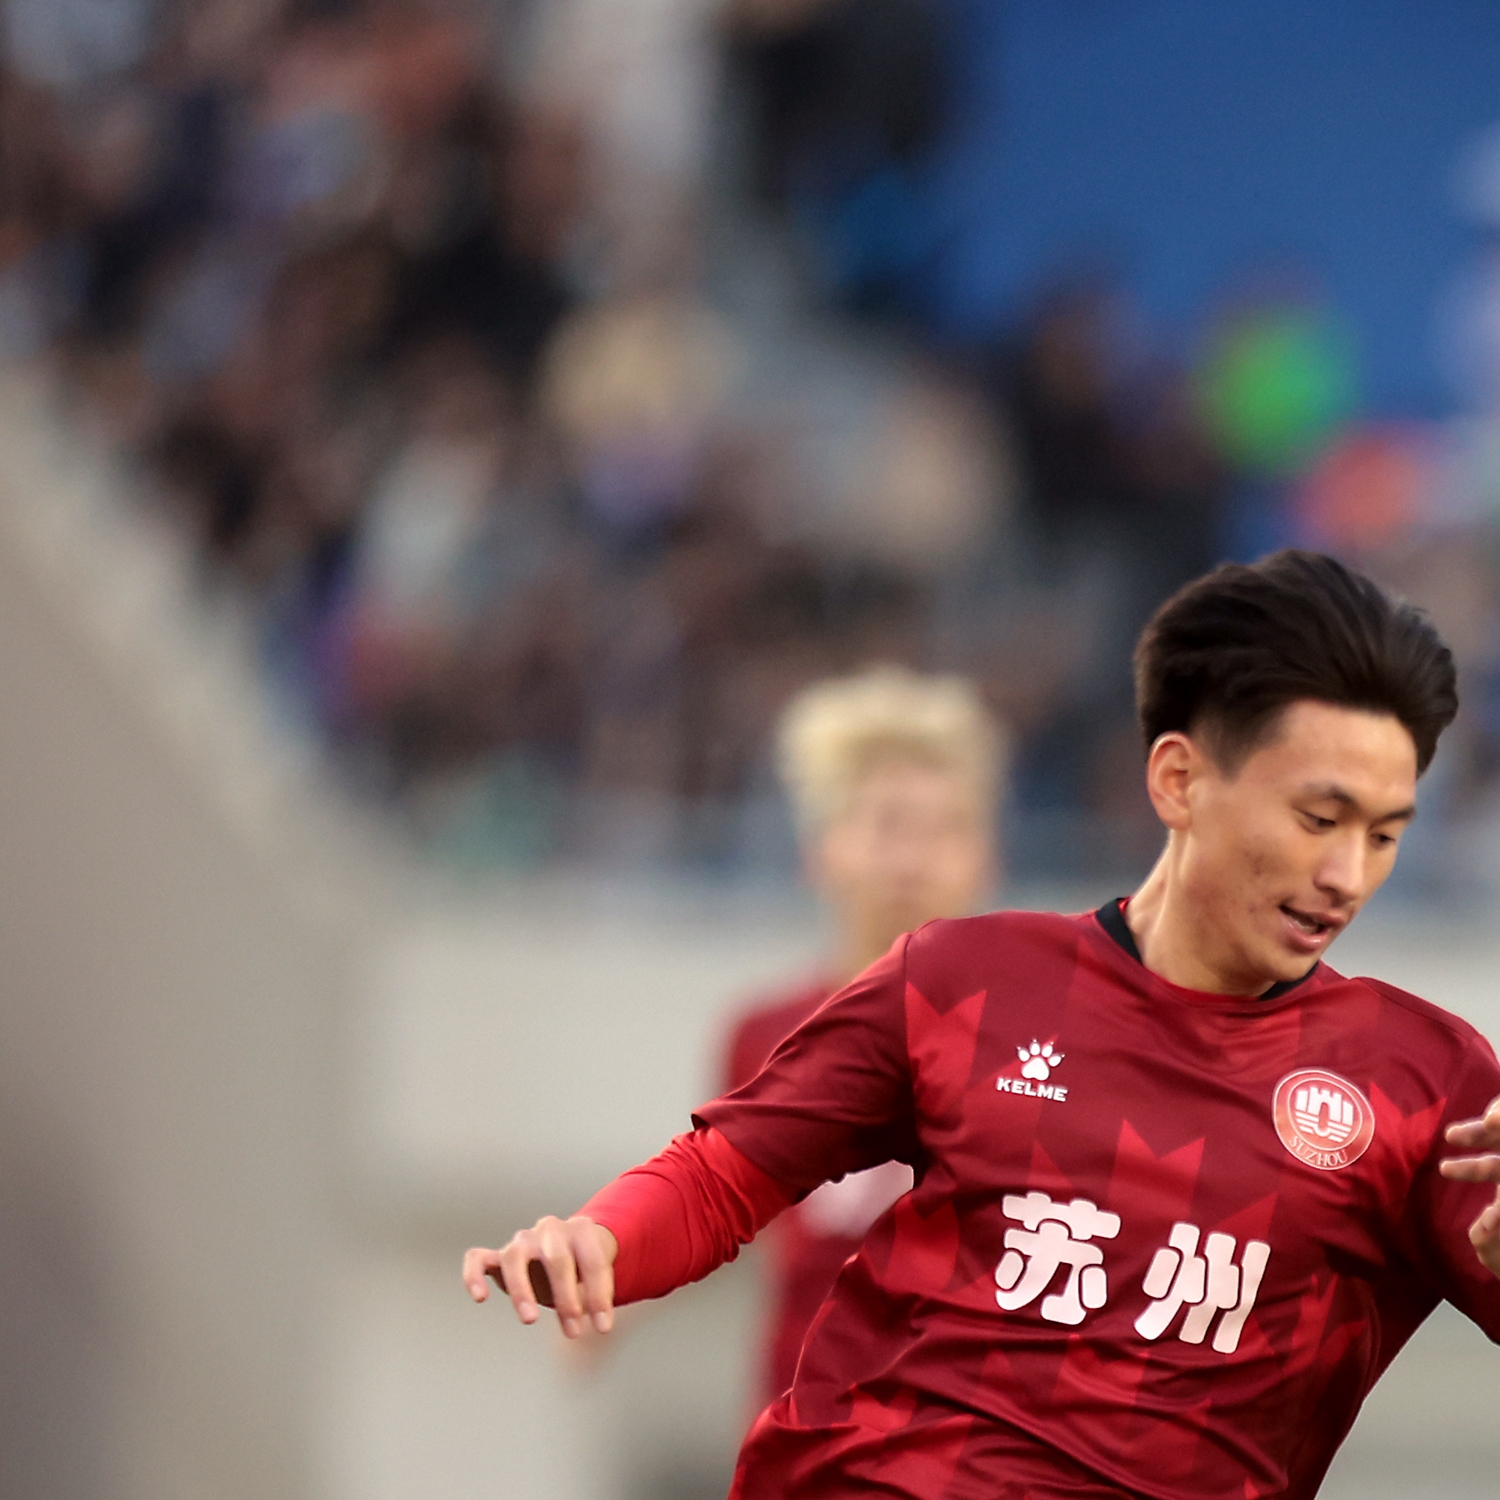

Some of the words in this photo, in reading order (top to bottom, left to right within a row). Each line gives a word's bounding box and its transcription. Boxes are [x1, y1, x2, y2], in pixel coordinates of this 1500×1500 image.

[997, 1077, 1068, 1102] KELME
[1289, 1136, 1348, 1167] SUZHOU
[995, 1192, 1271, 1354] 苏州
